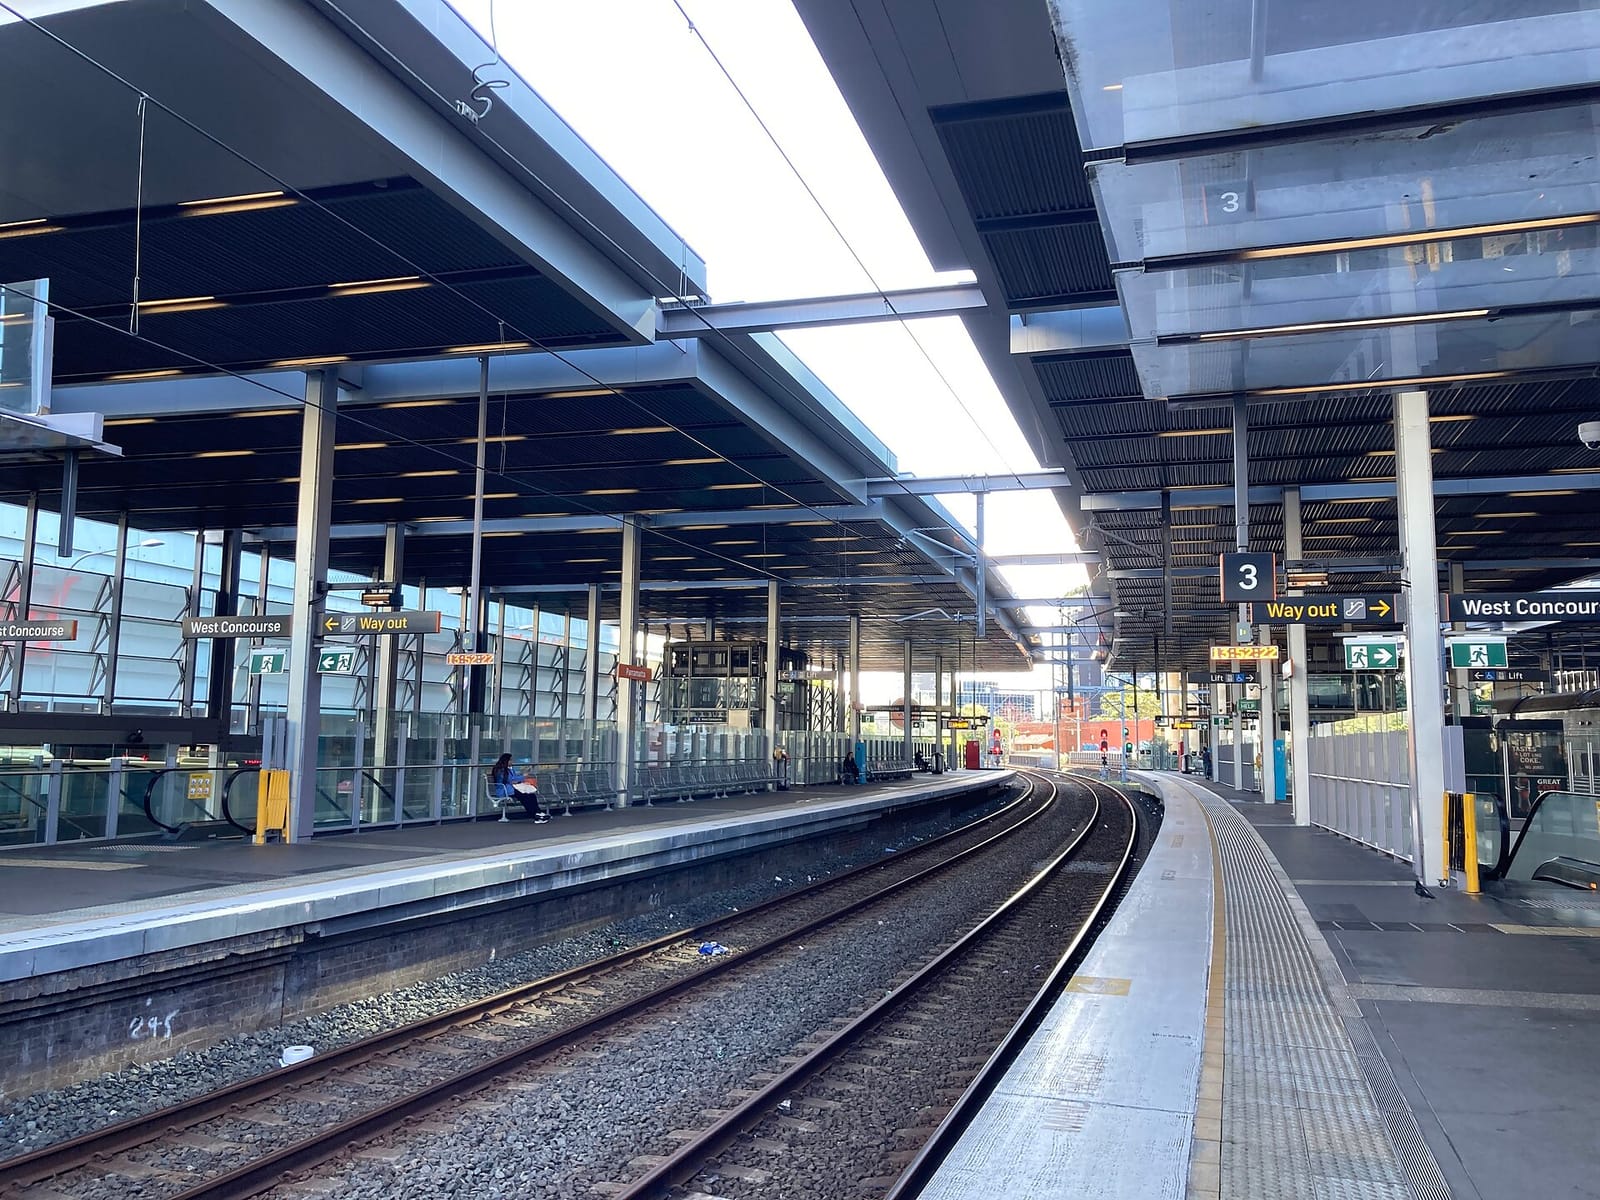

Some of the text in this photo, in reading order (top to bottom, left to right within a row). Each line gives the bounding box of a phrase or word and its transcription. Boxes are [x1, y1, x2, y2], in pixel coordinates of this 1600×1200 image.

[1238, 564, 1258, 590] 3
[1266, 603, 1338, 621] Way out
[1462, 599, 1600, 615] West Concour
[9, 625, 64, 636] Concourse
[190, 621, 281, 634] West Concourse
[359, 617, 408, 632] Way out
[1212, 647, 1278, 659] 13:52:22
[1210, 674, 1224, 682] Lift
[1508, 672, 1523, 680] Lift
